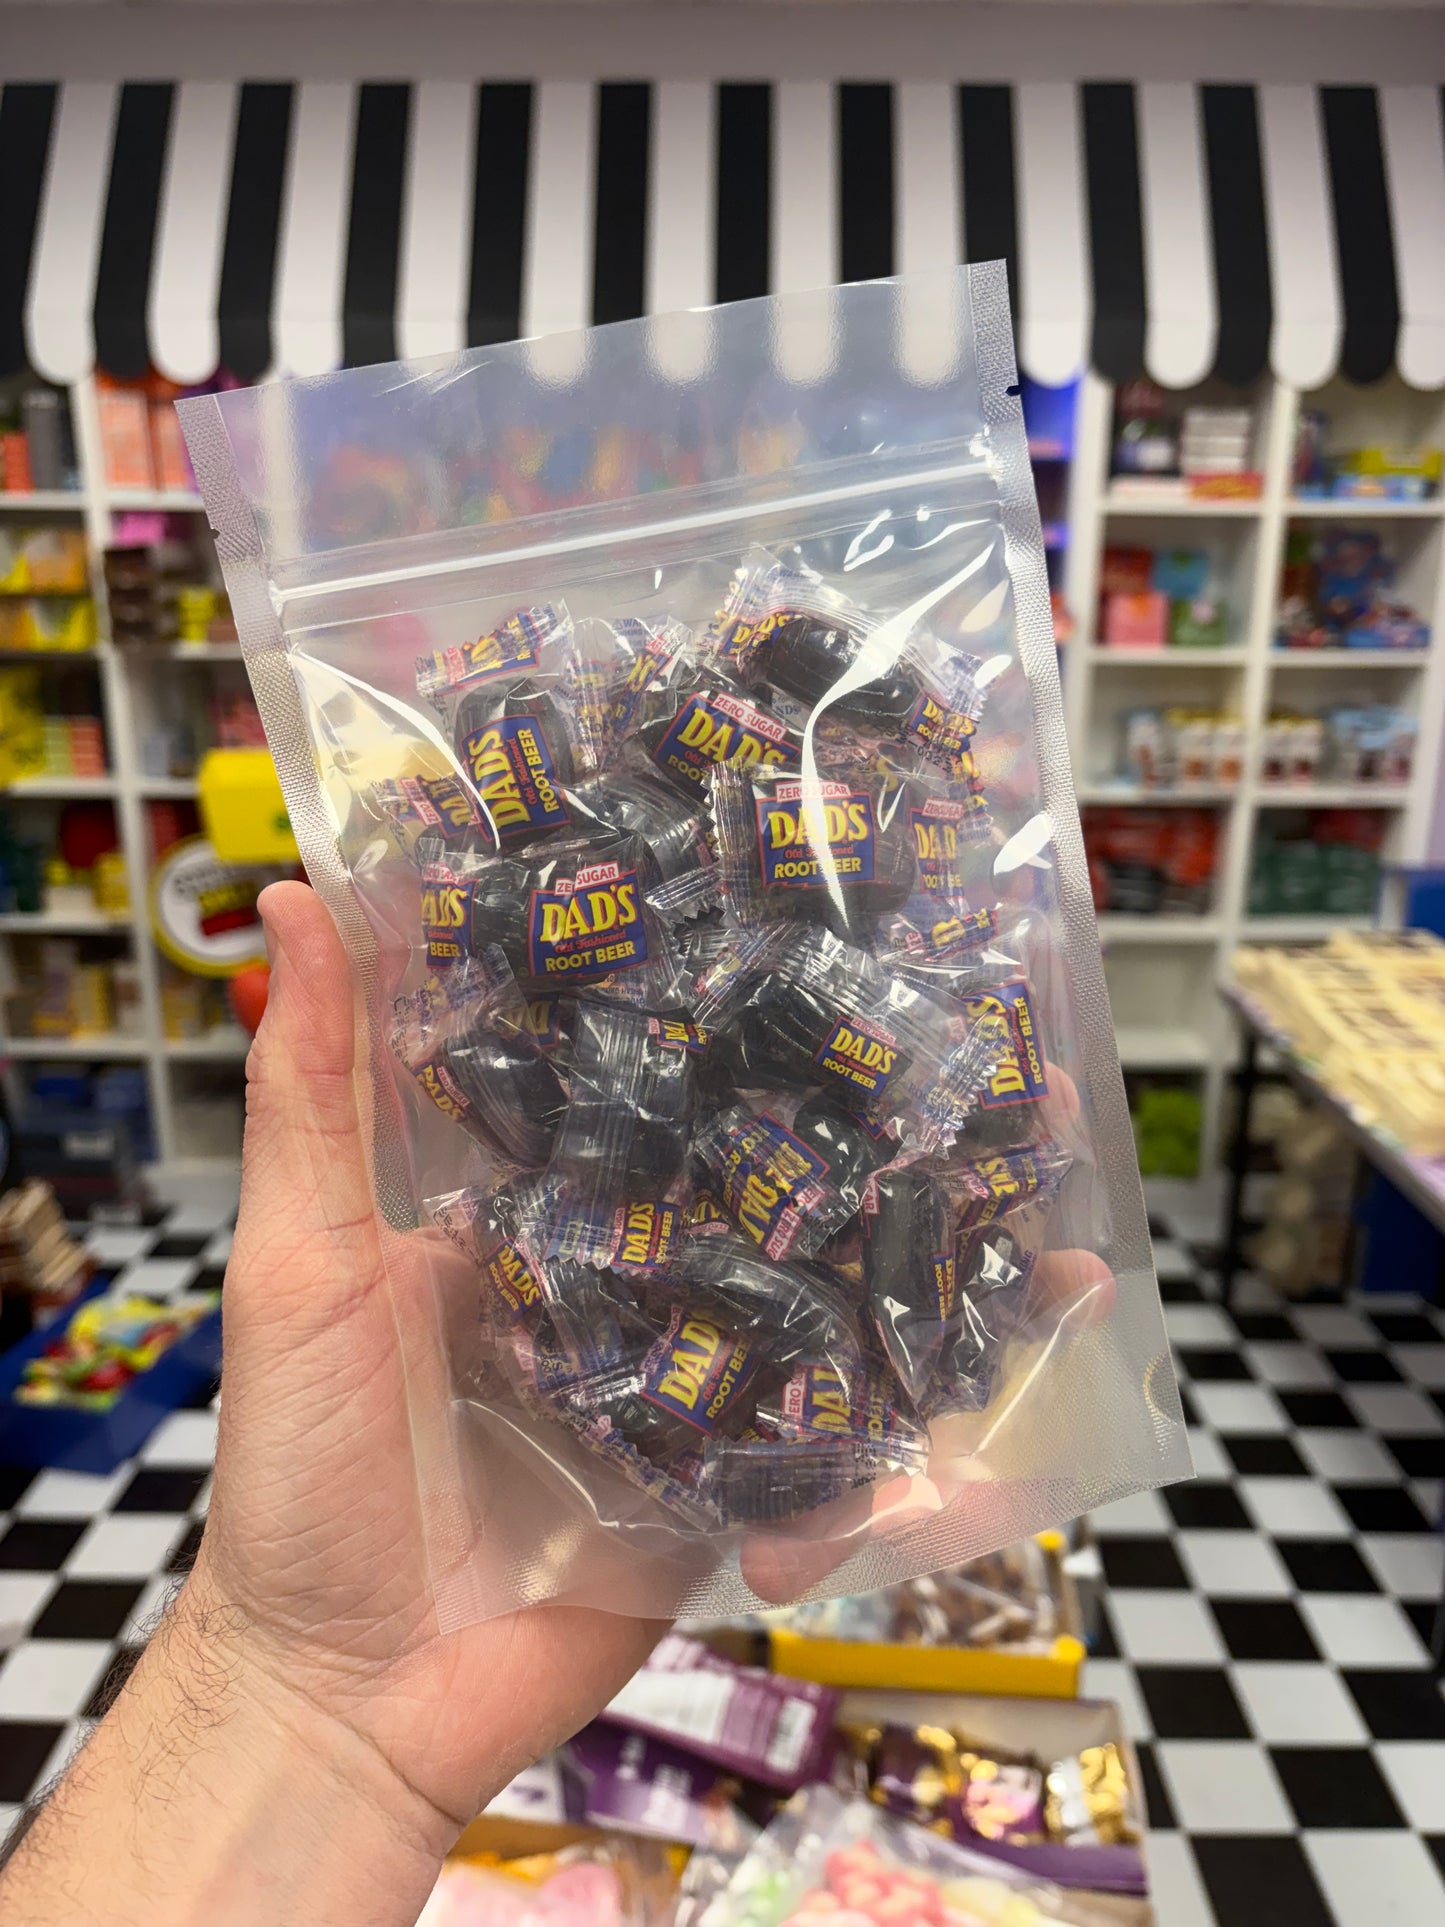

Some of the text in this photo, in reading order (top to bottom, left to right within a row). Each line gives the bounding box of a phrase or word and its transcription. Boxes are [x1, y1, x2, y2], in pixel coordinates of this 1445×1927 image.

[714, 696, 783, 740] ZERO SUGAR
[467, 728, 532, 829] DAD'S
[516, 727, 560, 813] ROOT BEER
[766, 800, 869, 849] DAD'S
[576, 866, 615, 885] SUGAR
[773, 860, 818, 879] ROOT
[540, 884, 636, 941] DAD'S
[430, 941, 460, 957] BEER
[545, 940, 636, 971] ROOT BEER
[829, 1026, 897, 1075] DAD'S
[1013, 996, 1044, 1085] ROOT BEER
[822, 1057, 877, 1091] ROOT BEER
[621, 1202, 655, 1264] DAD'S
[664, 1210, 674, 1238] BEER
[498, 1244, 541, 1306] DAD'S
[705, 1370, 736, 1419] ROOT
